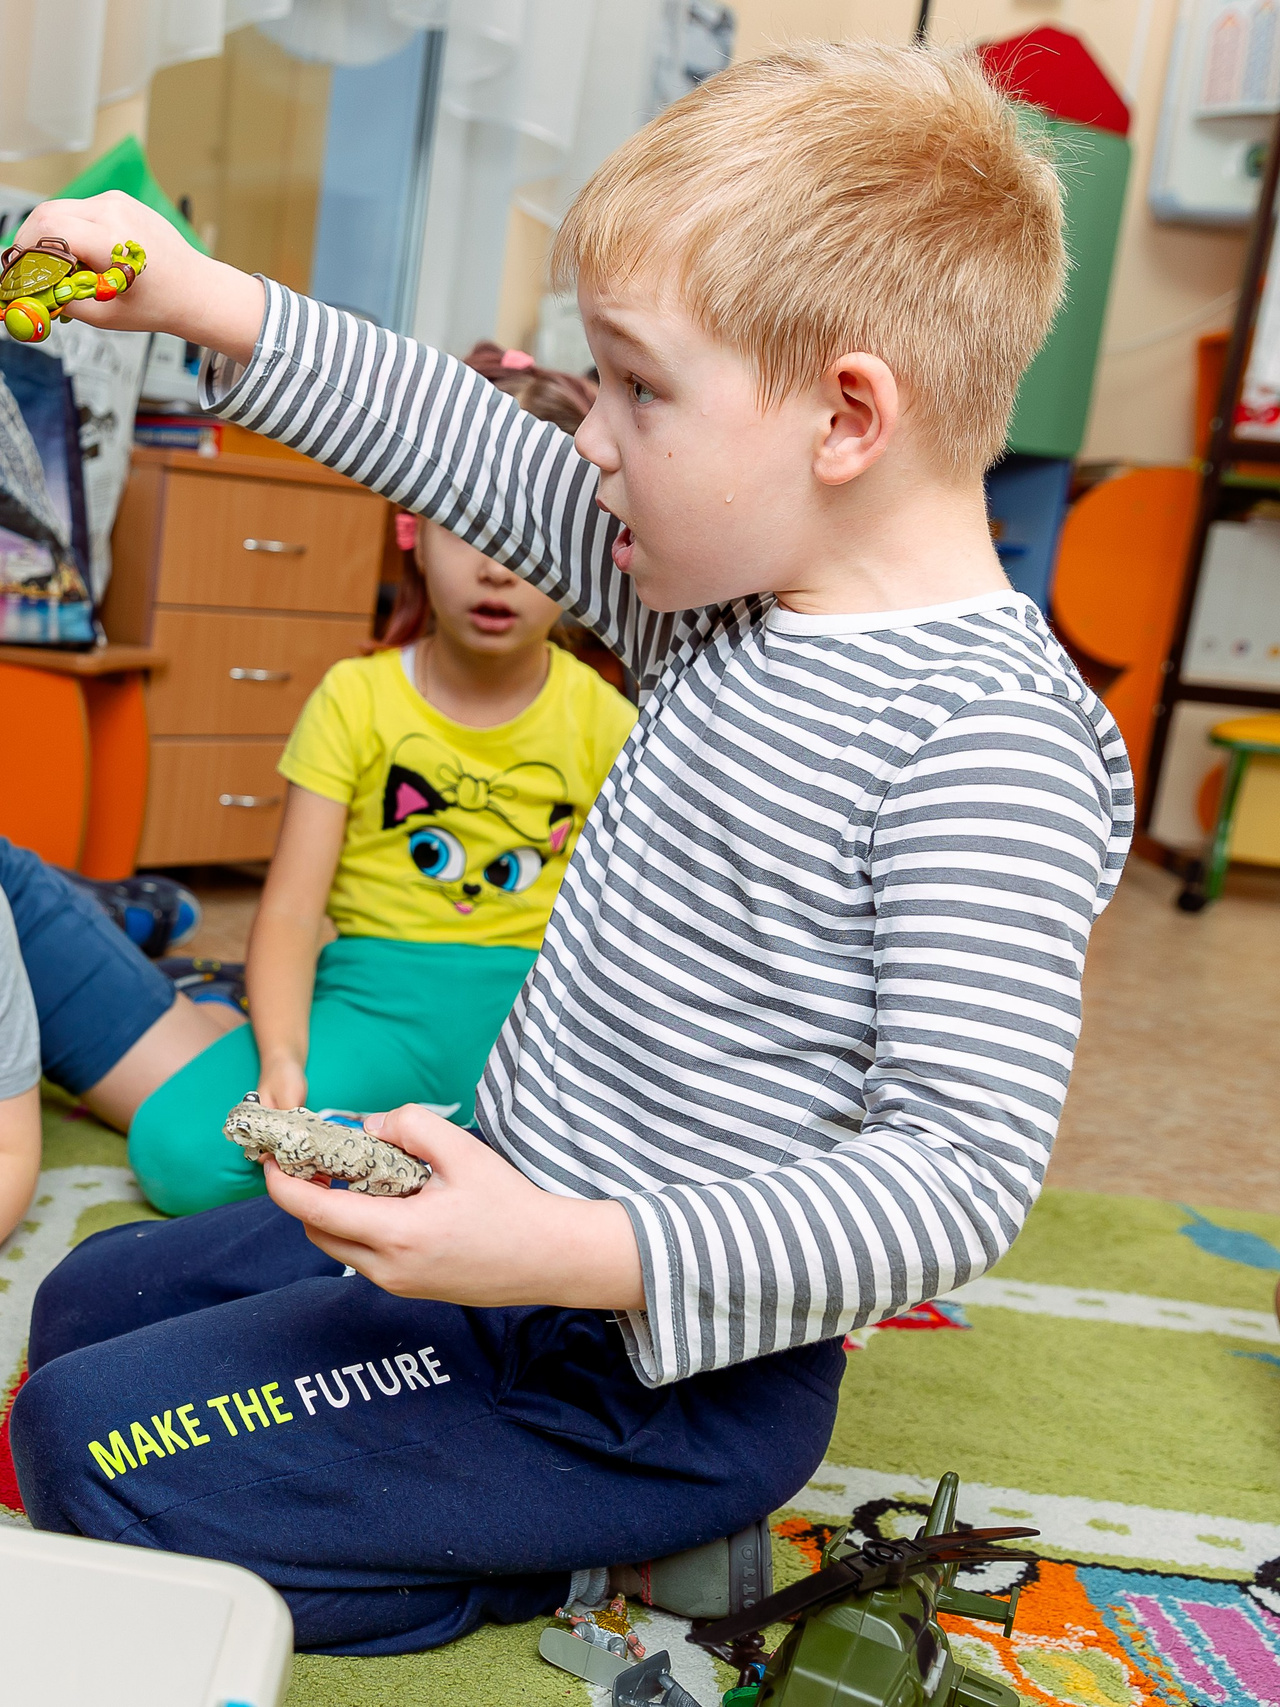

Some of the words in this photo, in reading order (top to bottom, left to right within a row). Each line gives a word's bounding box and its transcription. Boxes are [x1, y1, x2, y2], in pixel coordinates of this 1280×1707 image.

[87, 1403, 211, 1481] MAKE
[207, 1381, 294, 1437] THE
[294, 1346, 451, 1416] FUTURE
